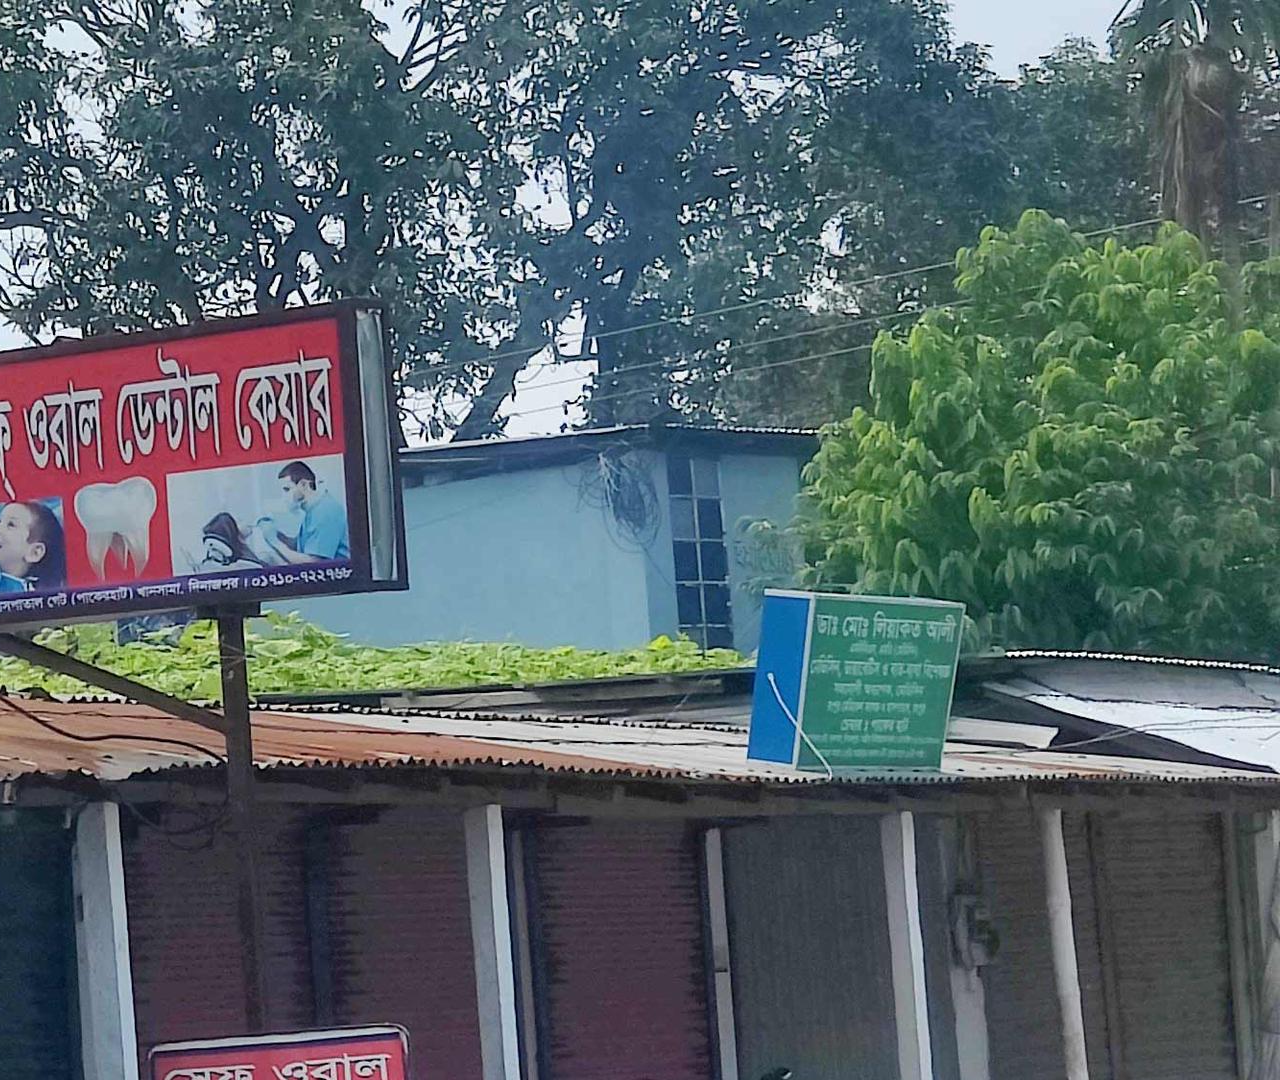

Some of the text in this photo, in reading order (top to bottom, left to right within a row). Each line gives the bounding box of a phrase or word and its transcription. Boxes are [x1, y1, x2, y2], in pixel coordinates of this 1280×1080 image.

[23, 380, 104, 475] ওরাল
[117, 347, 222, 466] ডেন্টাল
[234, 349, 334, 451] কেয়ার
[47, 592, 68, 609] গেট
[251, 567, 354, 588] ০১৭১০-৭২২৭৬৮
[816, 614, 839, 636] ডাঃ
[842, 616, 869, 638] মোঃ
[926, 614, 957, 643] আলী
